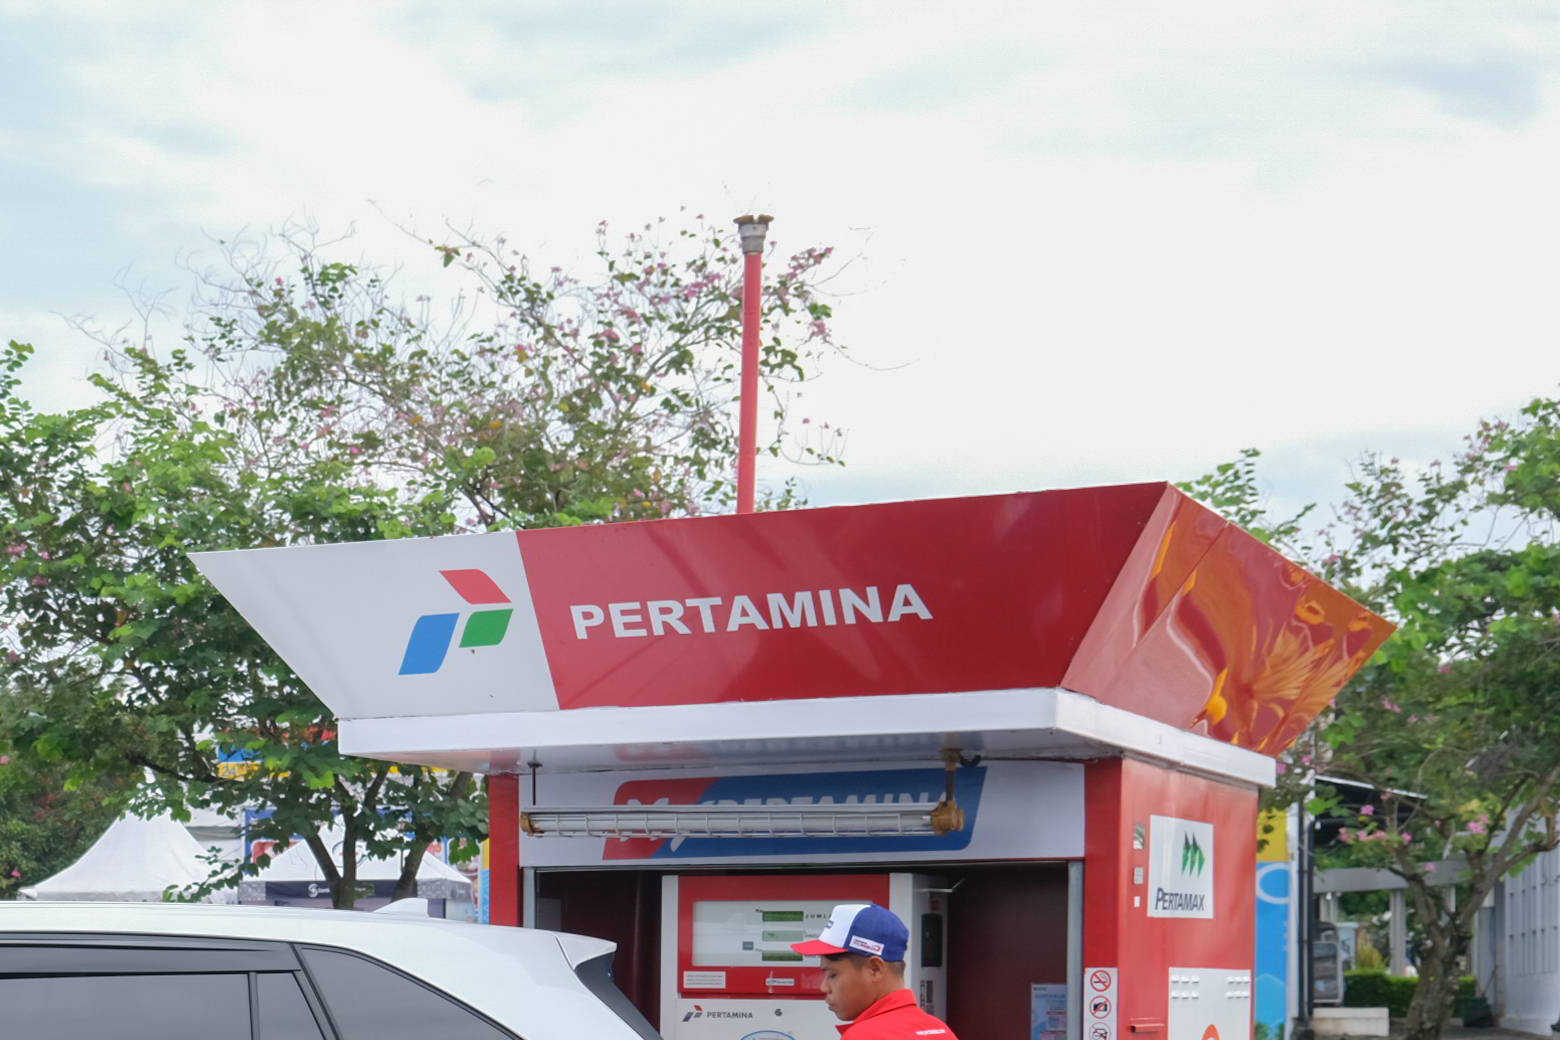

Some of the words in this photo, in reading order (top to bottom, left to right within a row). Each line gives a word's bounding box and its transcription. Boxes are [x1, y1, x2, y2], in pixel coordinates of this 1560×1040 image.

[570, 583, 934, 640] PERTAMINA
[1155, 887, 1205, 911] PERTAMAX
[707, 1011, 753, 1019] PERTAMINA
